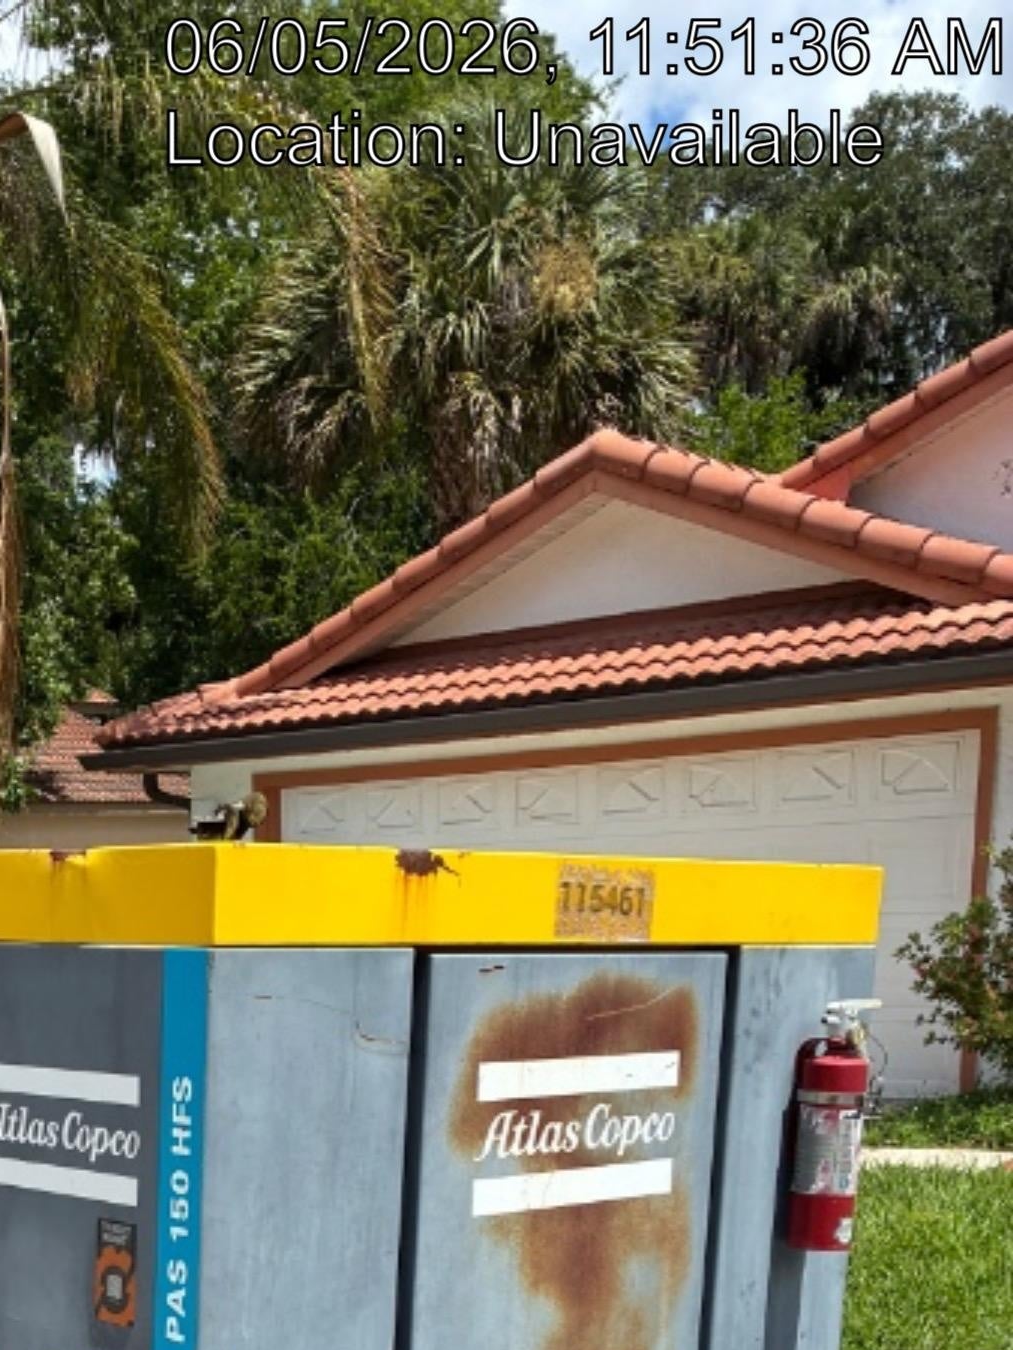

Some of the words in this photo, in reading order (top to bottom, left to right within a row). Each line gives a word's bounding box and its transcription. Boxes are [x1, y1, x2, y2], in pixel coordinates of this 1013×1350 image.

[560, 881, 645, 918] 115461
[61, 1110, 141, 1163] Copco
[171, 1076, 193, 1155] HFS
[473, 1108, 582, 1162] Atlas
[584, 1103, 676, 1156] Copco
[169, 1169, 190, 1242] 150
[166, 1259, 188, 1343] PAS
